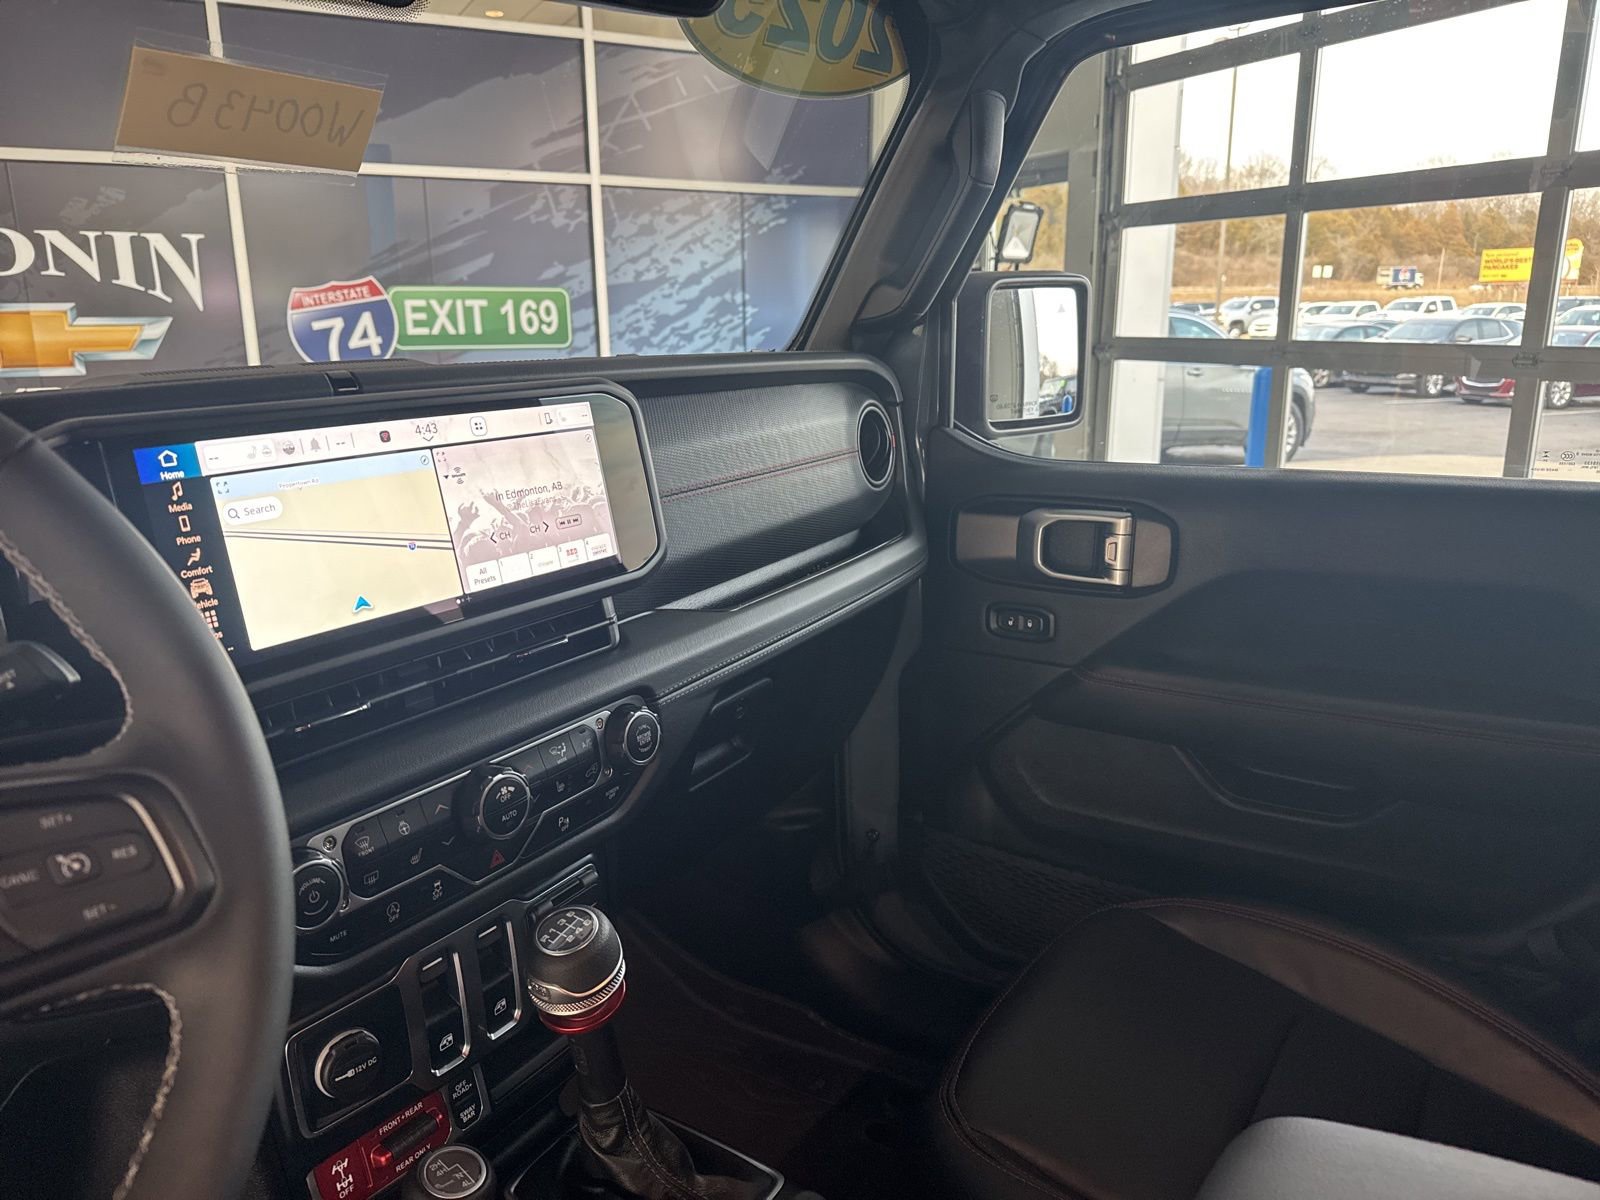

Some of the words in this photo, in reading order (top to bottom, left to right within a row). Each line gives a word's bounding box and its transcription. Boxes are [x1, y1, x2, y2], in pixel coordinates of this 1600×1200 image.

[302, 285, 371, 306] INTERSTATE
[404, 299, 488, 335] EXIT
[501, 299, 559, 335] 169
[311, 311, 383, 361] 74
[415, 422, 438, 435] 4:43
[160, 470, 184, 480] Home
[495, 491, 504, 501] In
[505, 484, 551, 501] Edmonton,
[552, 481, 563, 492] AB
[168, 502, 193, 513] Media
[243, 503, 276, 516] Search
[529, 525, 541, 534] CH
[176, 535, 201, 546] Phone
[499, 532, 511, 541] CH
[181, 565, 213, 579] Comfort
[479, 567, 488, 576] All
[474, 575, 497, 586] Presets
[193, 598, 219, 610] ehicle
[500, 793, 512, 803] OFF
[502, 810, 518, 822] AUTO
[358, 846, 375, 857] FRONT
[301, 877, 321, 891] VOLUME
[389, 914, 400, 923] OFF
[329, 929, 348, 943] MUTE
[355, 1062, 367, 1074] 12V
[367, 1056, 377, 1067] DC
[452, 1083, 473, 1100] ROAD+
[454, 1079, 468, 1092] OFF
[459, 1103, 477, 1119] SWAY
[462, 1110, 476, 1123] BAR
[395, 1155, 414, 1174] REAR
[414, 1143, 432, 1163] ONLY
[429, 1159, 443, 1171] 2H
[436, 1167, 448, 1178] 4H
[461, 1178, 473, 1188] 4L
[339, 1185, 355, 1200] OFF
